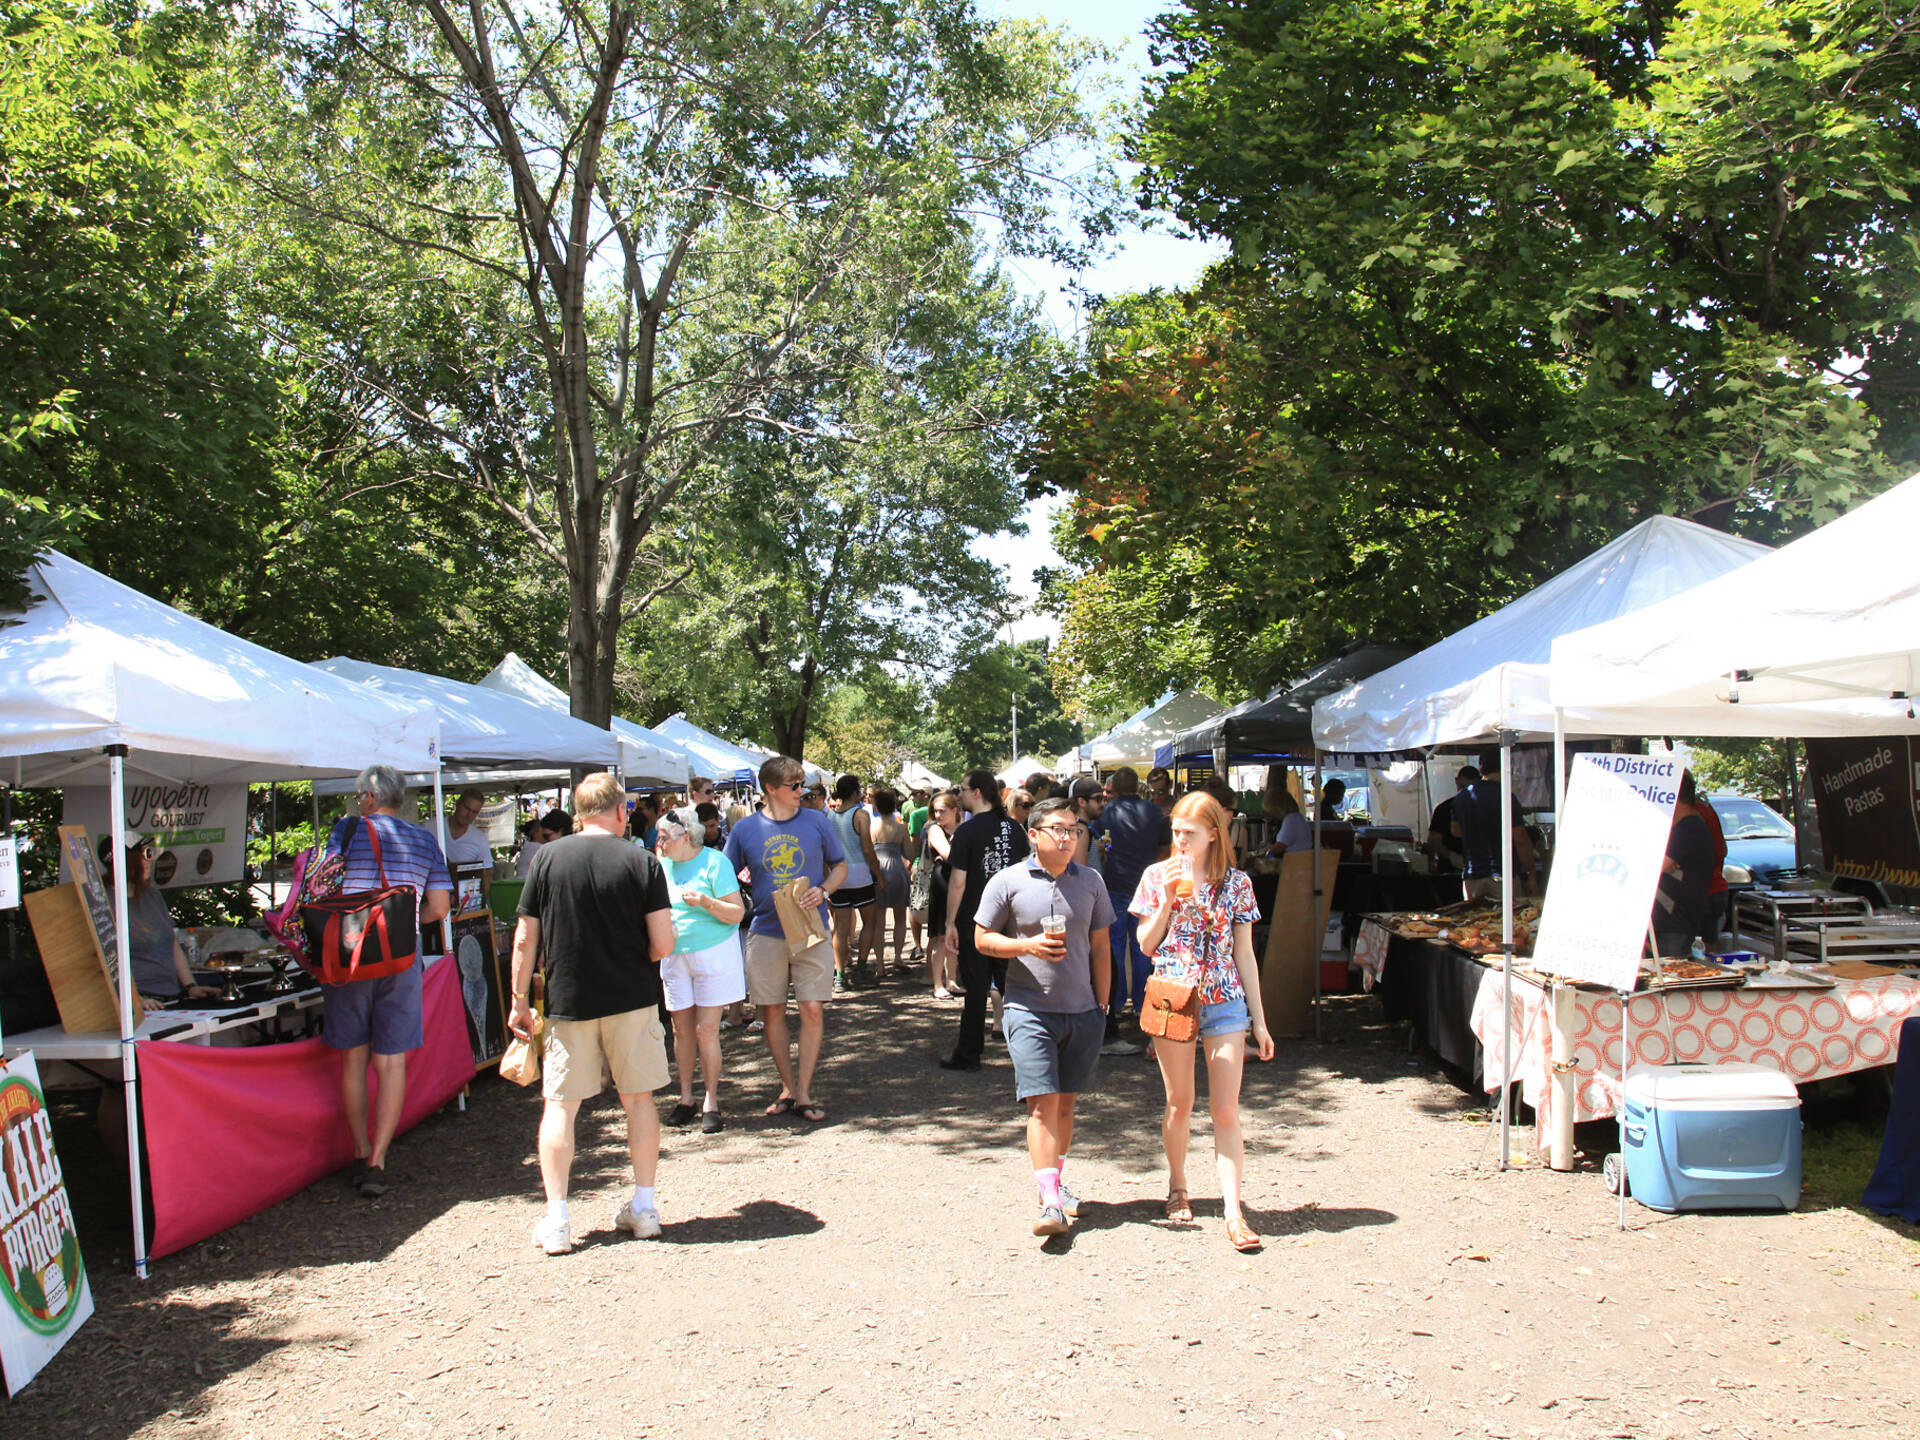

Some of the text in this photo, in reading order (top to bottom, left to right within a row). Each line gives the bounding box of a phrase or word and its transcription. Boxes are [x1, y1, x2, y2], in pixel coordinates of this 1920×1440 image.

[1614, 757, 1674, 777] District
[1822, 746, 1893, 795] Handmade
[1844, 787, 1885, 816] Pastas
[151, 812, 205, 828] GOURMET
